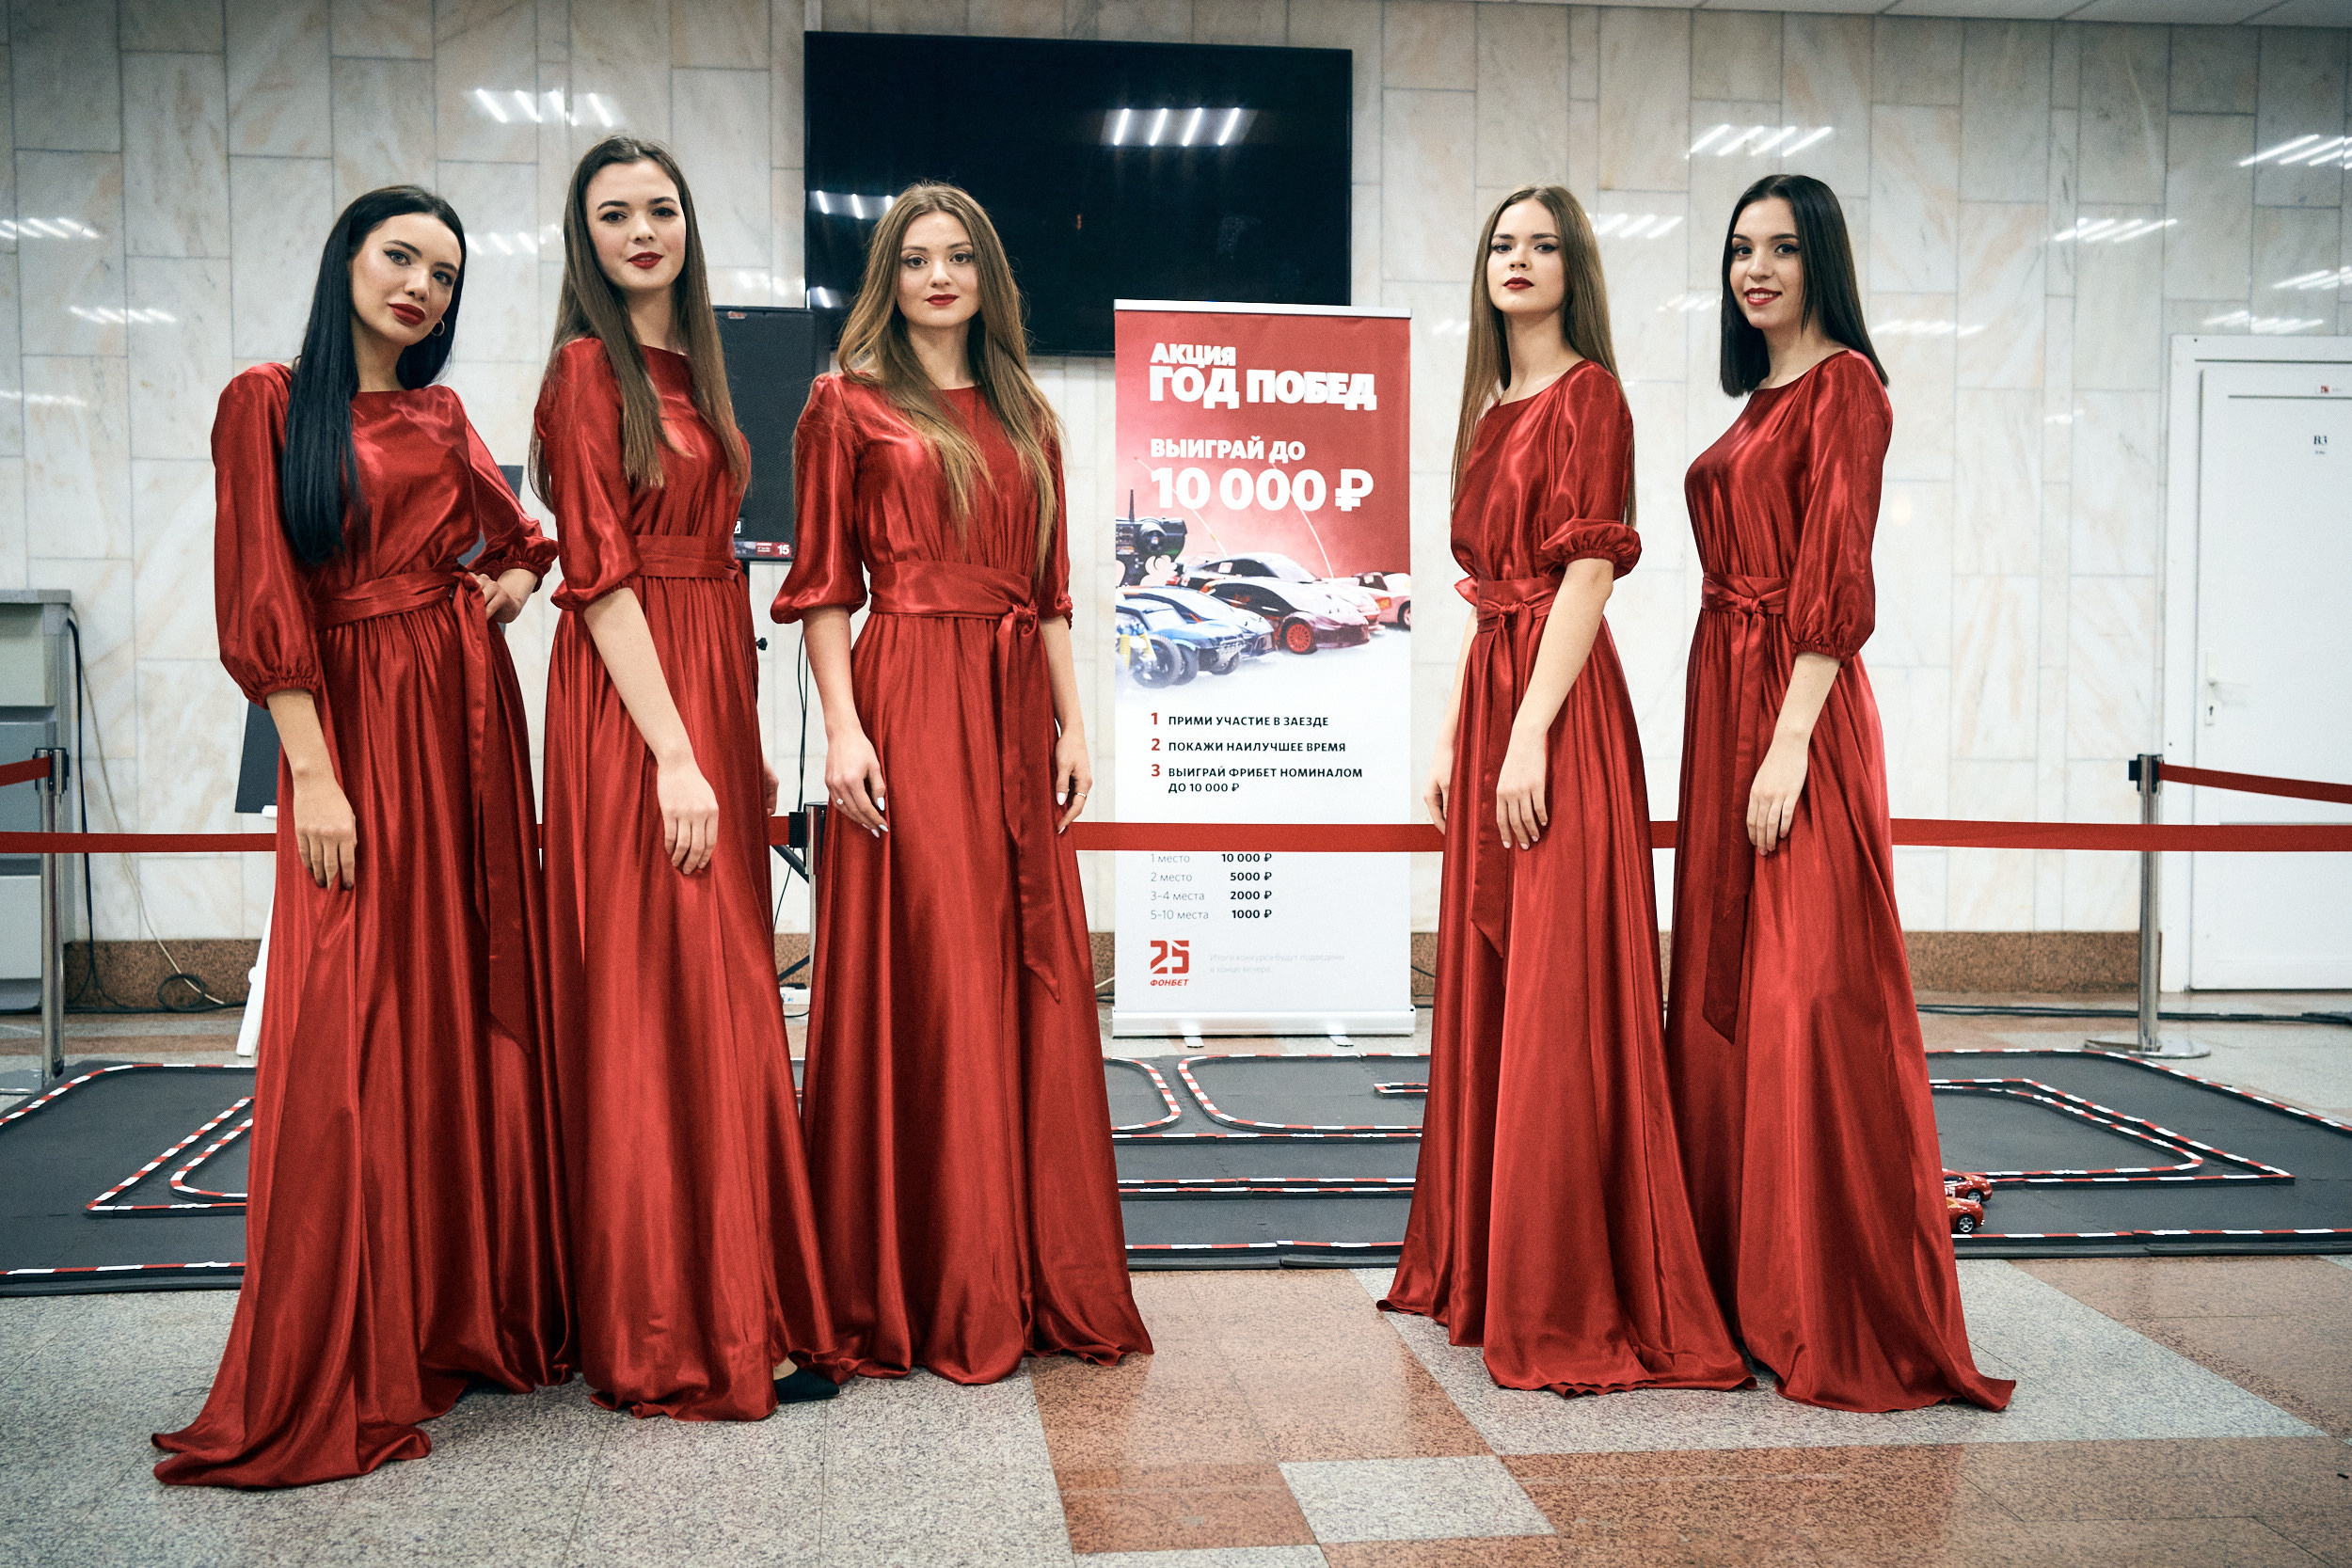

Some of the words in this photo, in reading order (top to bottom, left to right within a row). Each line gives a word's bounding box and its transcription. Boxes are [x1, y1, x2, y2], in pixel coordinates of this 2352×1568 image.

[1150, 342, 1236, 368] АКЦИЯ
[1149, 365, 1240, 409] ГОД
[1246, 369, 1377, 411] ПОБЕД
[1151, 436, 1264, 459] ВЫИГРАЙ
[1268, 440, 1306, 464] ДО
[1151, 467, 1211, 510] 10
[1219, 467, 1327, 512] 000
[1151, 712, 1158, 725] 1
[1168, 716, 1213, 726] ПРИМИ
[1216, 716, 1271, 726] УЧАСТИЕ
[1273, 717, 1280, 726] В
[1283, 716, 1329, 728] ЗАЕЗДЕ
[1151, 737, 1161, 752] 2
[1168, 741, 1224, 752] ПОКАЖИ
[1227, 742, 1304, 752] НАИЛУЧШЕЕ
[1306, 742, 1346, 752] ВРЕМЯ
[1151, 763, 1161, 777] 3
[1168, 766, 1226, 777] ВЫИГРАЙ
[1228, 767, 1278, 778] ФРИБЕТ
[1279, 768, 1363, 778] НОМИНАЛОМ
[1168, 783, 1186, 794] ДО
[1189, 783, 1202, 792] 10
[1204, 783, 1229, 793] 000
[1150, 853, 1155, 863] 1
[1157, 855, 1191, 863] место
[1221, 853, 1234, 863] 10
[1236, 853, 1261, 863] 000
[1150, 871, 1157, 882] 2
[1159, 874, 1193, 882] место
[1230, 872, 1261, 881] 5000
[1150, 890, 1170, 901] 3-4
[1172, 893, 1205, 901] места
[1230, 890, 1261, 900] 2000
[1150, 909, 1174, 920] 5-10
[1177, 911, 1209, 920] места
[1232, 909, 1261, 919] 1000
[1150, 940, 1189, 974] 25
[1150, 978, 1189, 987] ФОНБЕТ
